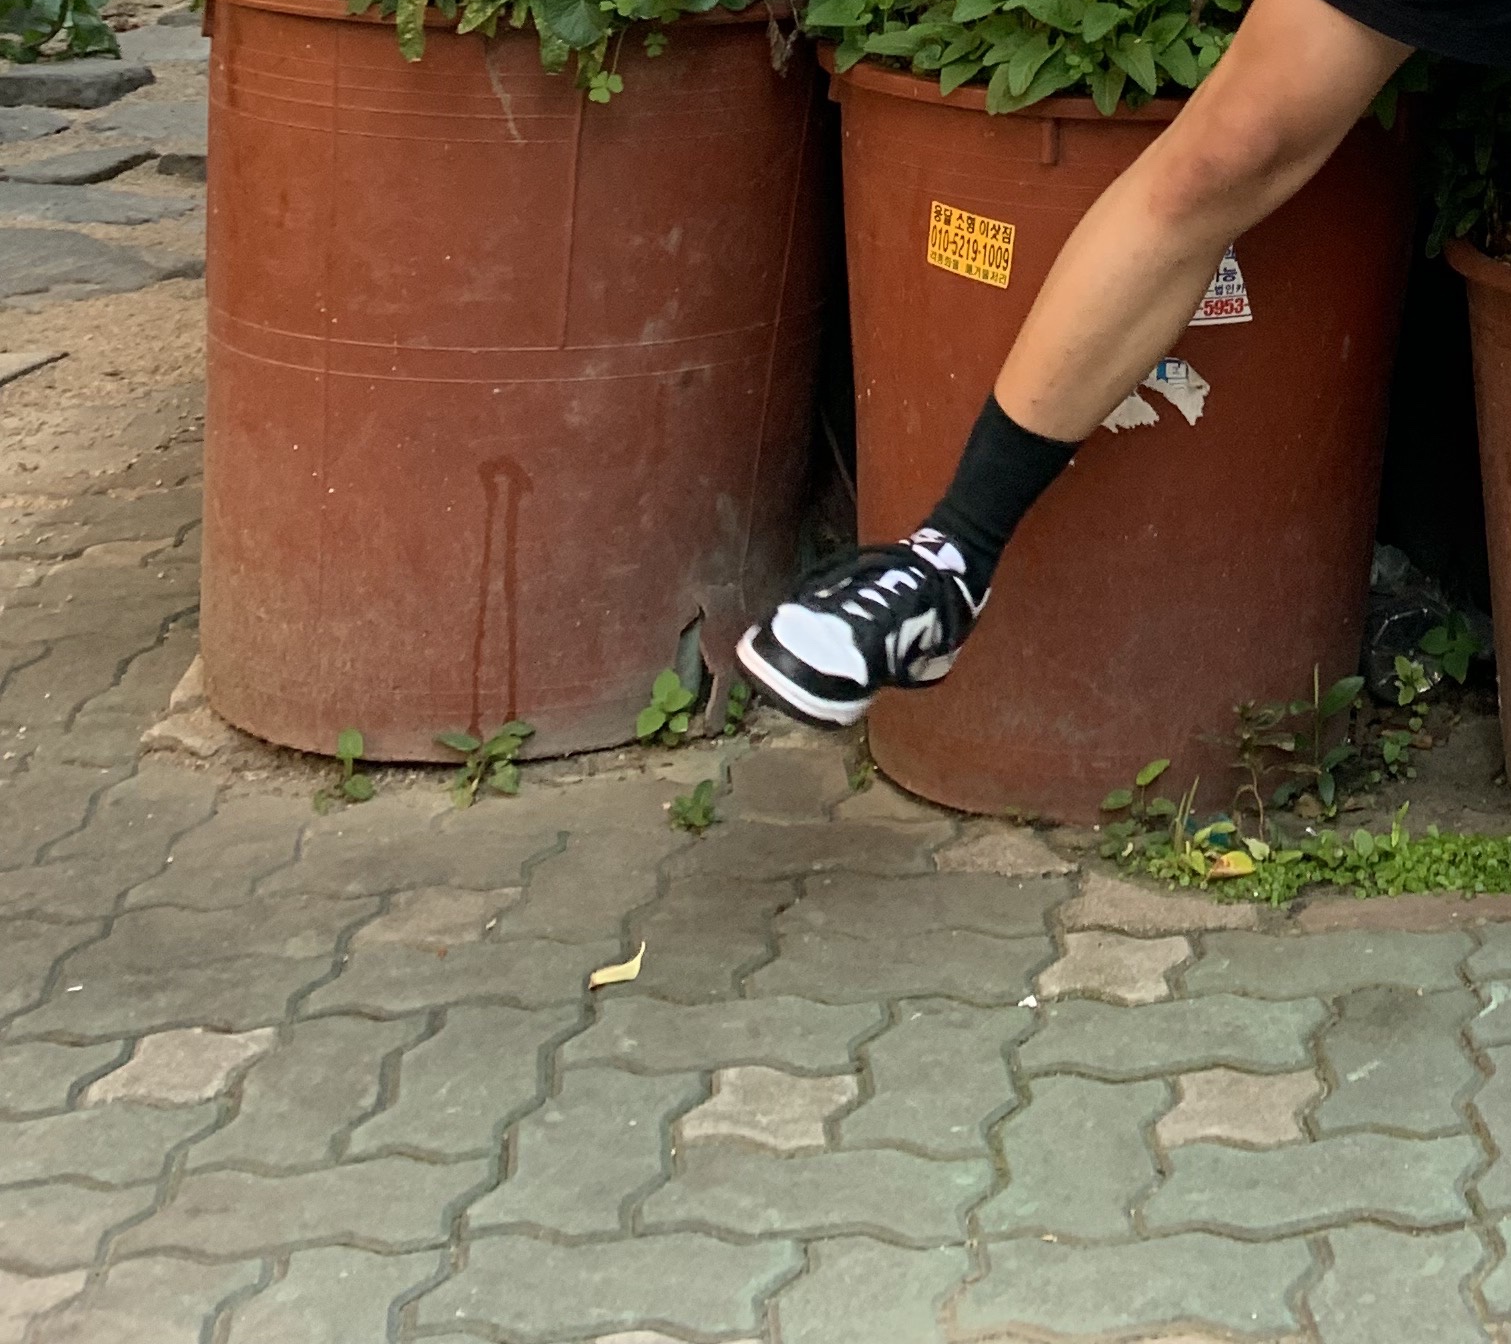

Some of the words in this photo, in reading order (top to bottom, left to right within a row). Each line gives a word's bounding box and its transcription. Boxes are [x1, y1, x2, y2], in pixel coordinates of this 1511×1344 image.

[934, 204, 953, 226] 용달
[955, 213, 976, 234] 소형
[979, 219, 1013, 245] 이삿짐
